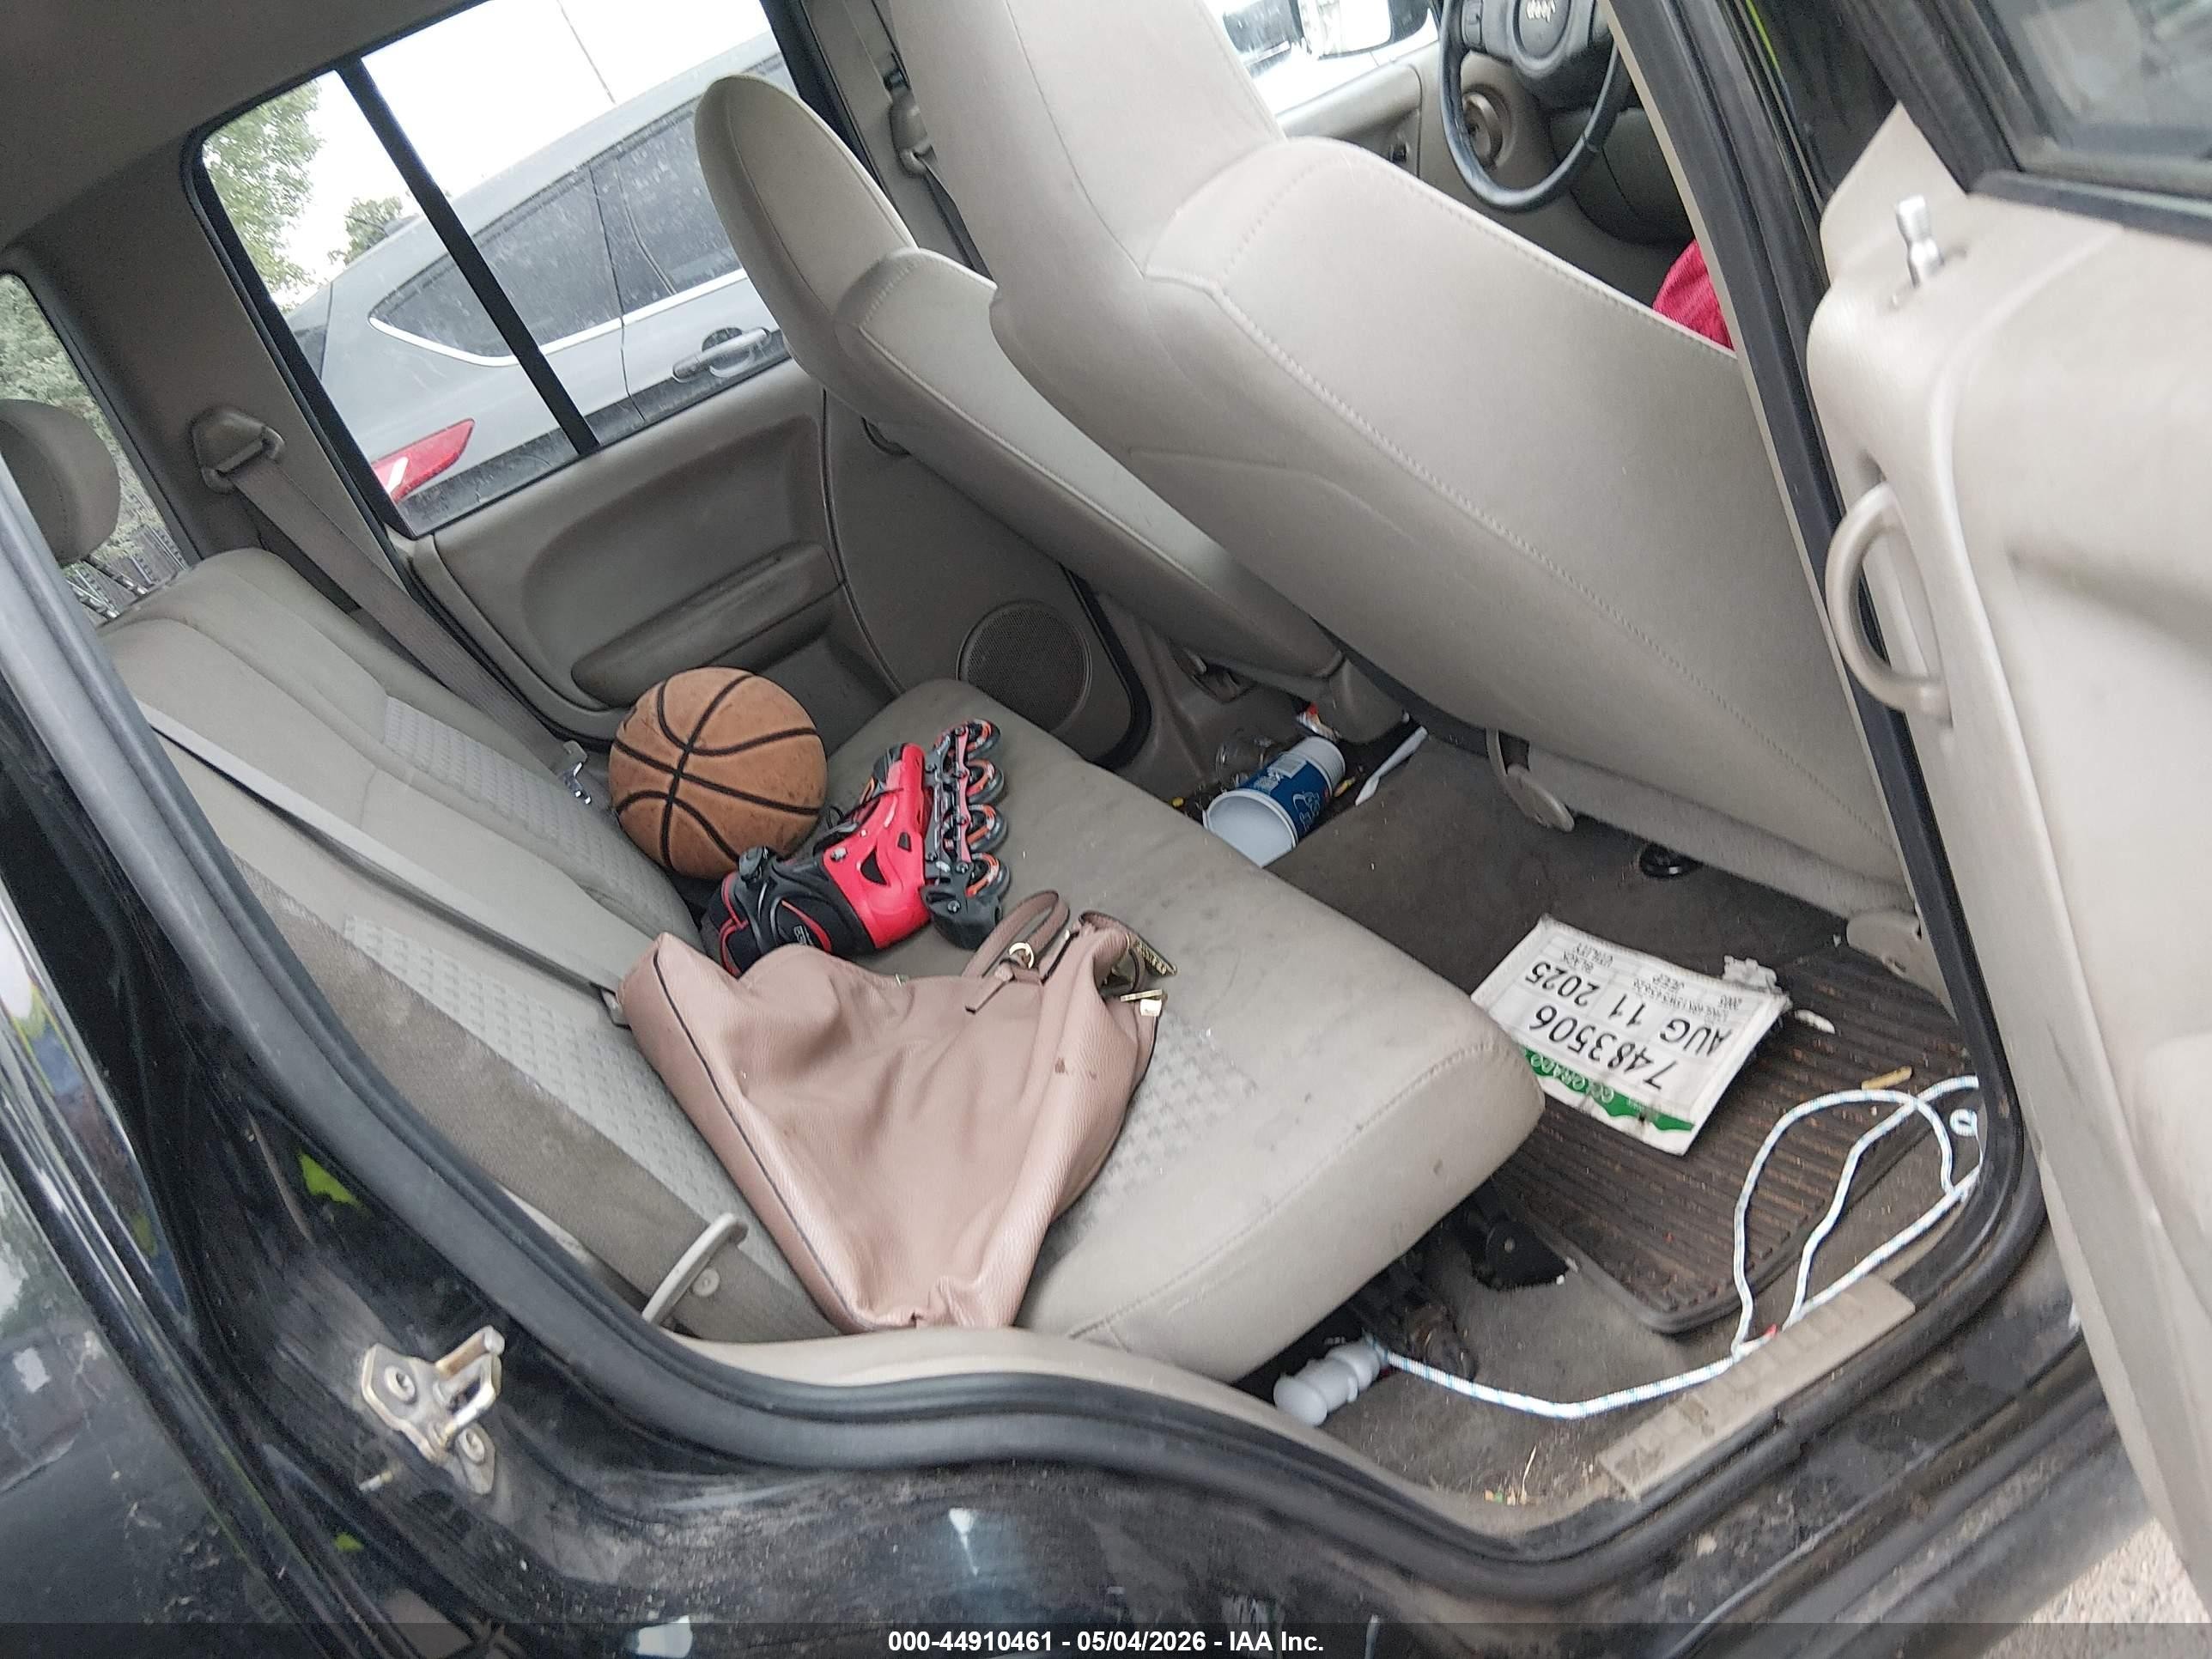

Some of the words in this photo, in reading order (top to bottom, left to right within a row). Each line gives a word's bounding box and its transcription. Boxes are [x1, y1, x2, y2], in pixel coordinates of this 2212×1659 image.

[1525, 961, 1600, 1006] 2025
[1608, 994, 1645, 1027] 11
[1529, 1005, 1677, 1090] 7483506
[1660, 1018, 1731, 1055] AUG
[1530, 1053, 1614, 1103] COORADO
